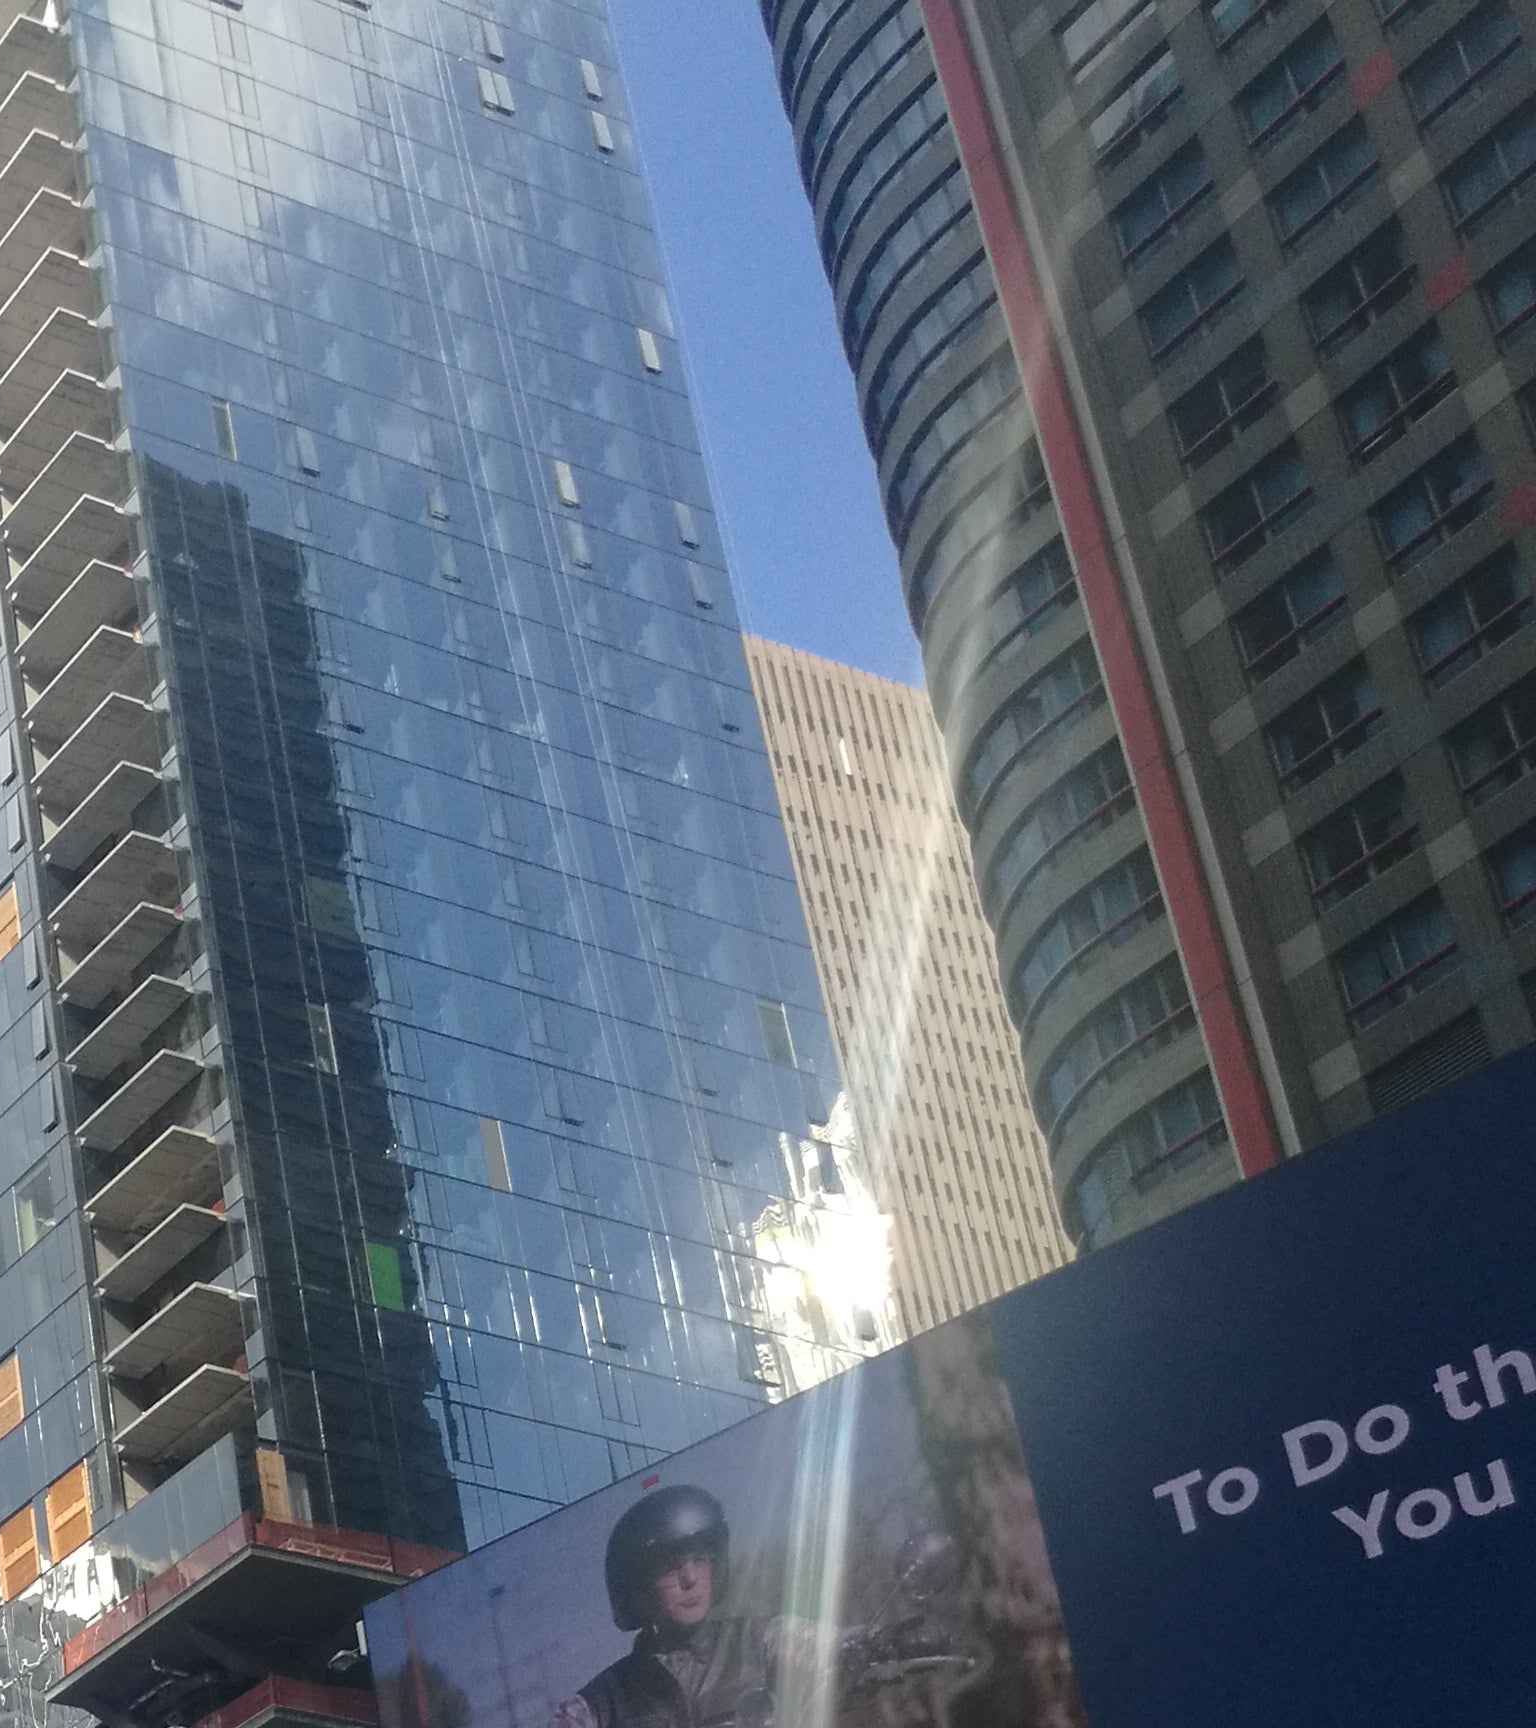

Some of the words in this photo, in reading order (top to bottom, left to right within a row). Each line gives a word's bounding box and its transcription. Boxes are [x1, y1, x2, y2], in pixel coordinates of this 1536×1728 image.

[1152, 1466, 1260, 1535] To
[1282, 1402, 1411, 1488] Do
[1332, 1458, 1516, 1560] You
